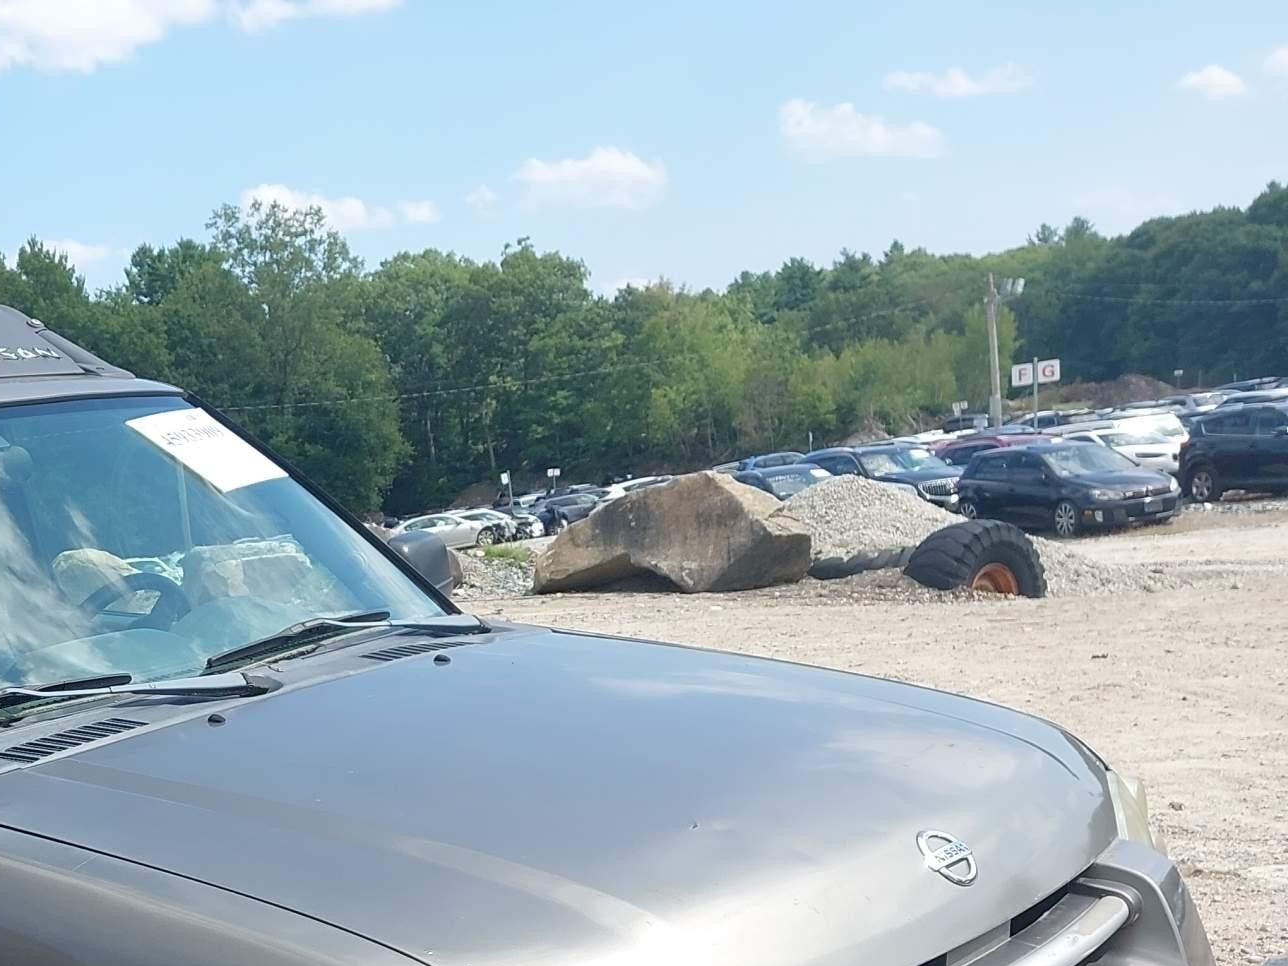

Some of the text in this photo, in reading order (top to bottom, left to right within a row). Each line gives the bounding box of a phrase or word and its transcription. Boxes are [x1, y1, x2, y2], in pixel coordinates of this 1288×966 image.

[1017, 367, 1028, 382] F
[1042, 364, 1055, 378] G
[934, 842, 969, 863] NISSAN
